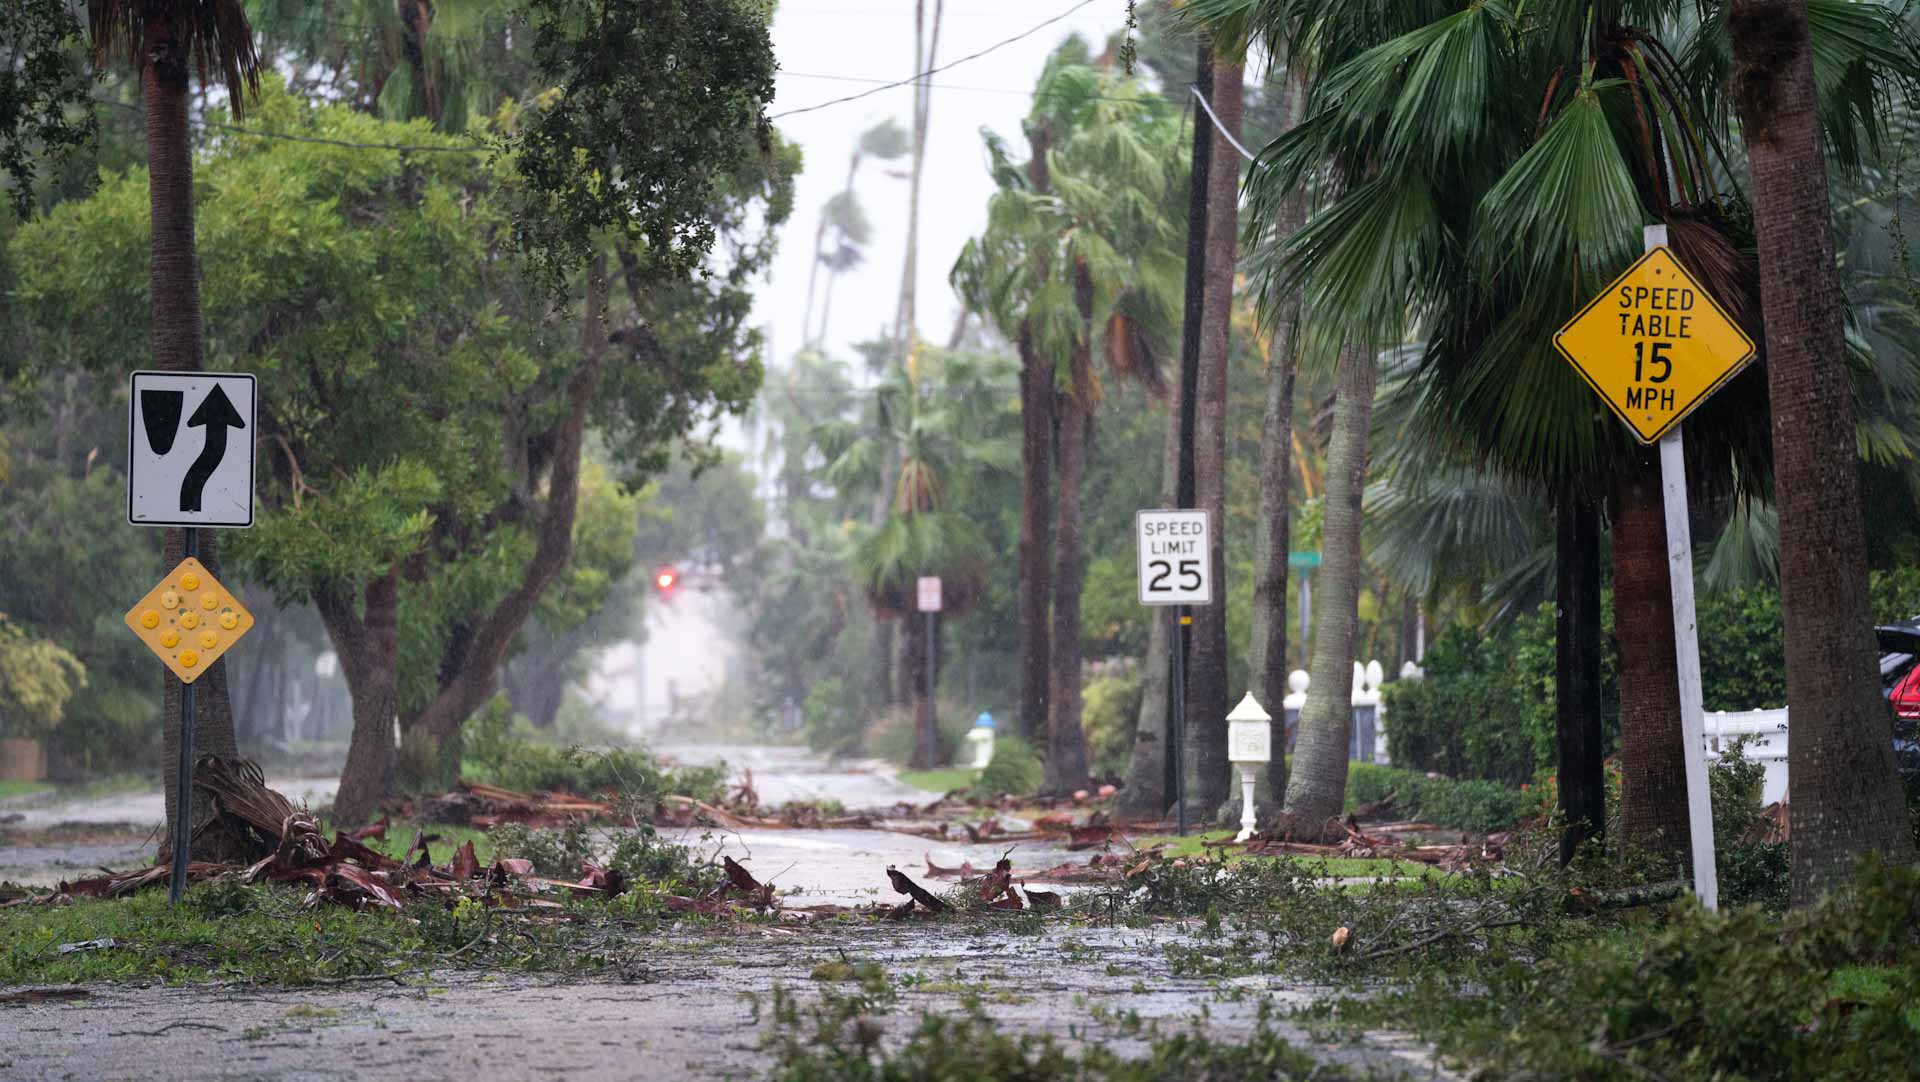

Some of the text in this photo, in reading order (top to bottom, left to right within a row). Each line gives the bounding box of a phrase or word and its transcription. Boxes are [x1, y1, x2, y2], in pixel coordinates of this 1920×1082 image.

[1619, 286, 1694, 311] SPEED
[1619, 313, 1692, 338] TABLE
[1634, 341, 1672, 383] 15
[1626, 387, 1674, 411] MPH
[1144, 522, 1203, 536] SPEED
[1151, 541, 1195, 555] LIMIT
[1148, 560, 1202, 592] 25
